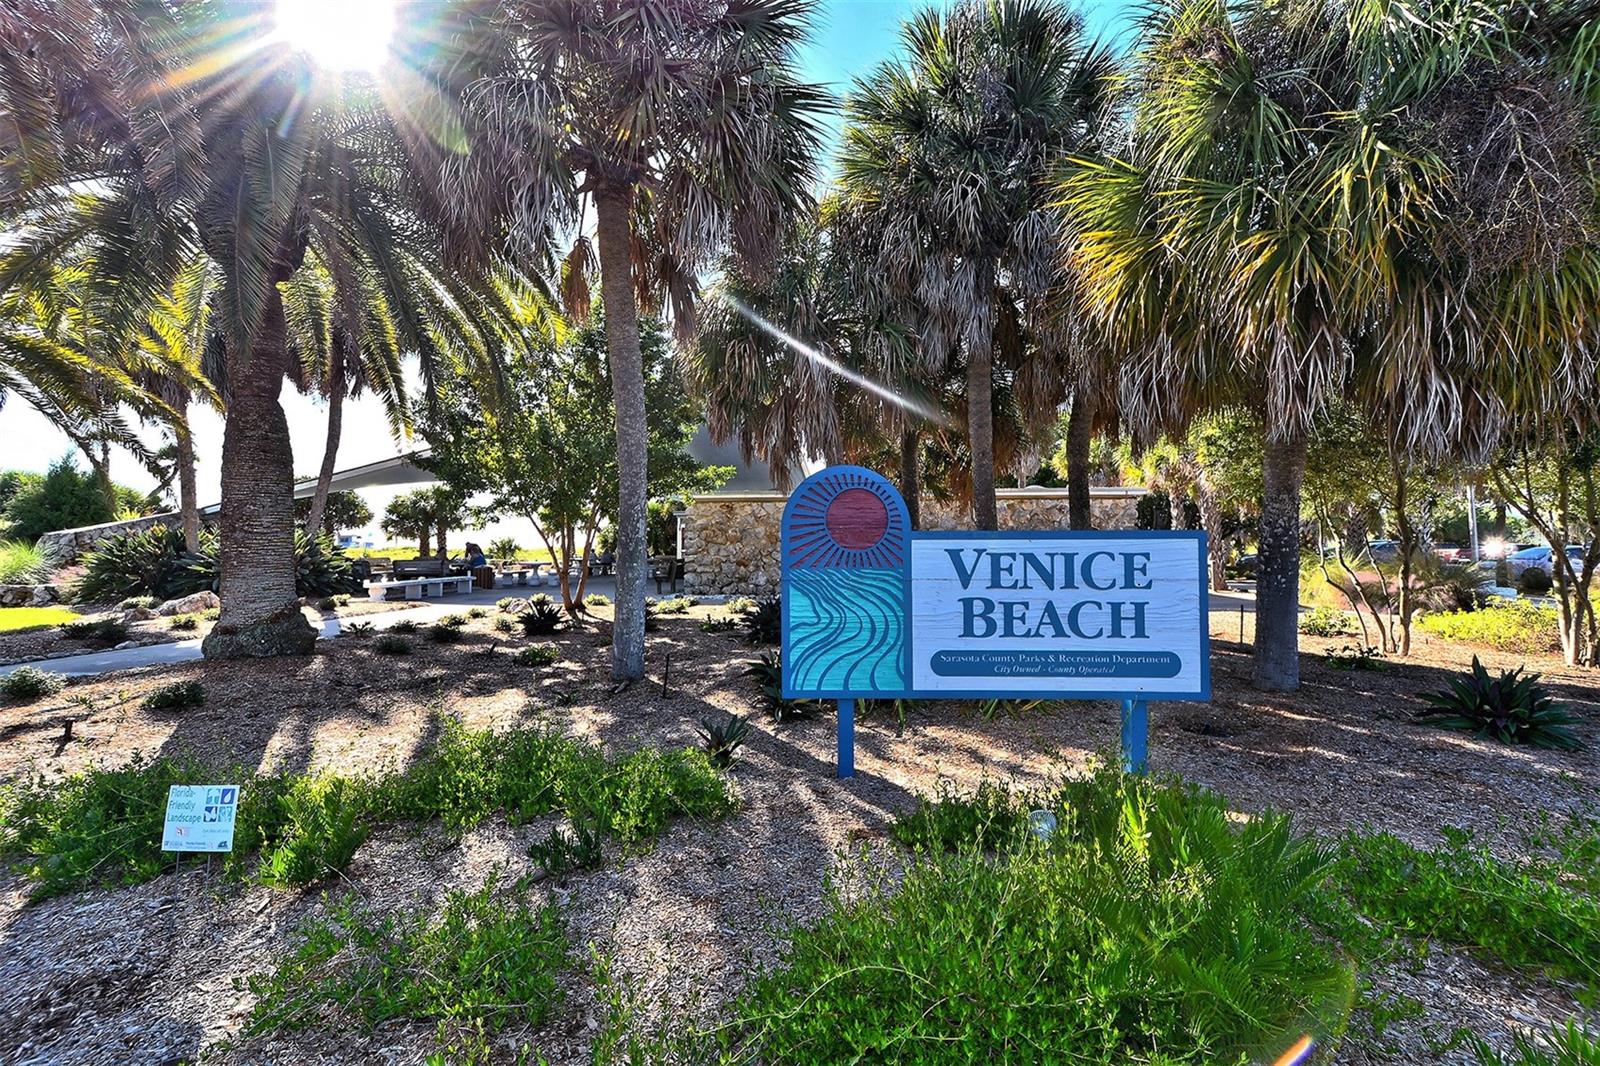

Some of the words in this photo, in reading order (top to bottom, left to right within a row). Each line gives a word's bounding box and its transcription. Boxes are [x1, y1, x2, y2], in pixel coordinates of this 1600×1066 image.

[944, 548, 1153, 591] VENICE
[957, 597, 1150, 639] BEACH
[940, 654, 980, 663] Sarasota
[982, 654, 1016, 664] County
[1019, 654, 1045, 663] Parks
[1047, 654, 1056, 663] &
[1059, 654, 1110, 663] Recreation
[1113, 654, 1170, 665] Department
[994, 665, 1011, 674] City
[1012, 665, 1041, 673] Owned
[1048, 665, 1076, 675] County
[1078, 665, 1116, 675] Operated
[168, 800, 196, 811] Friendly
[166, 813, 202, 824] Landscape
